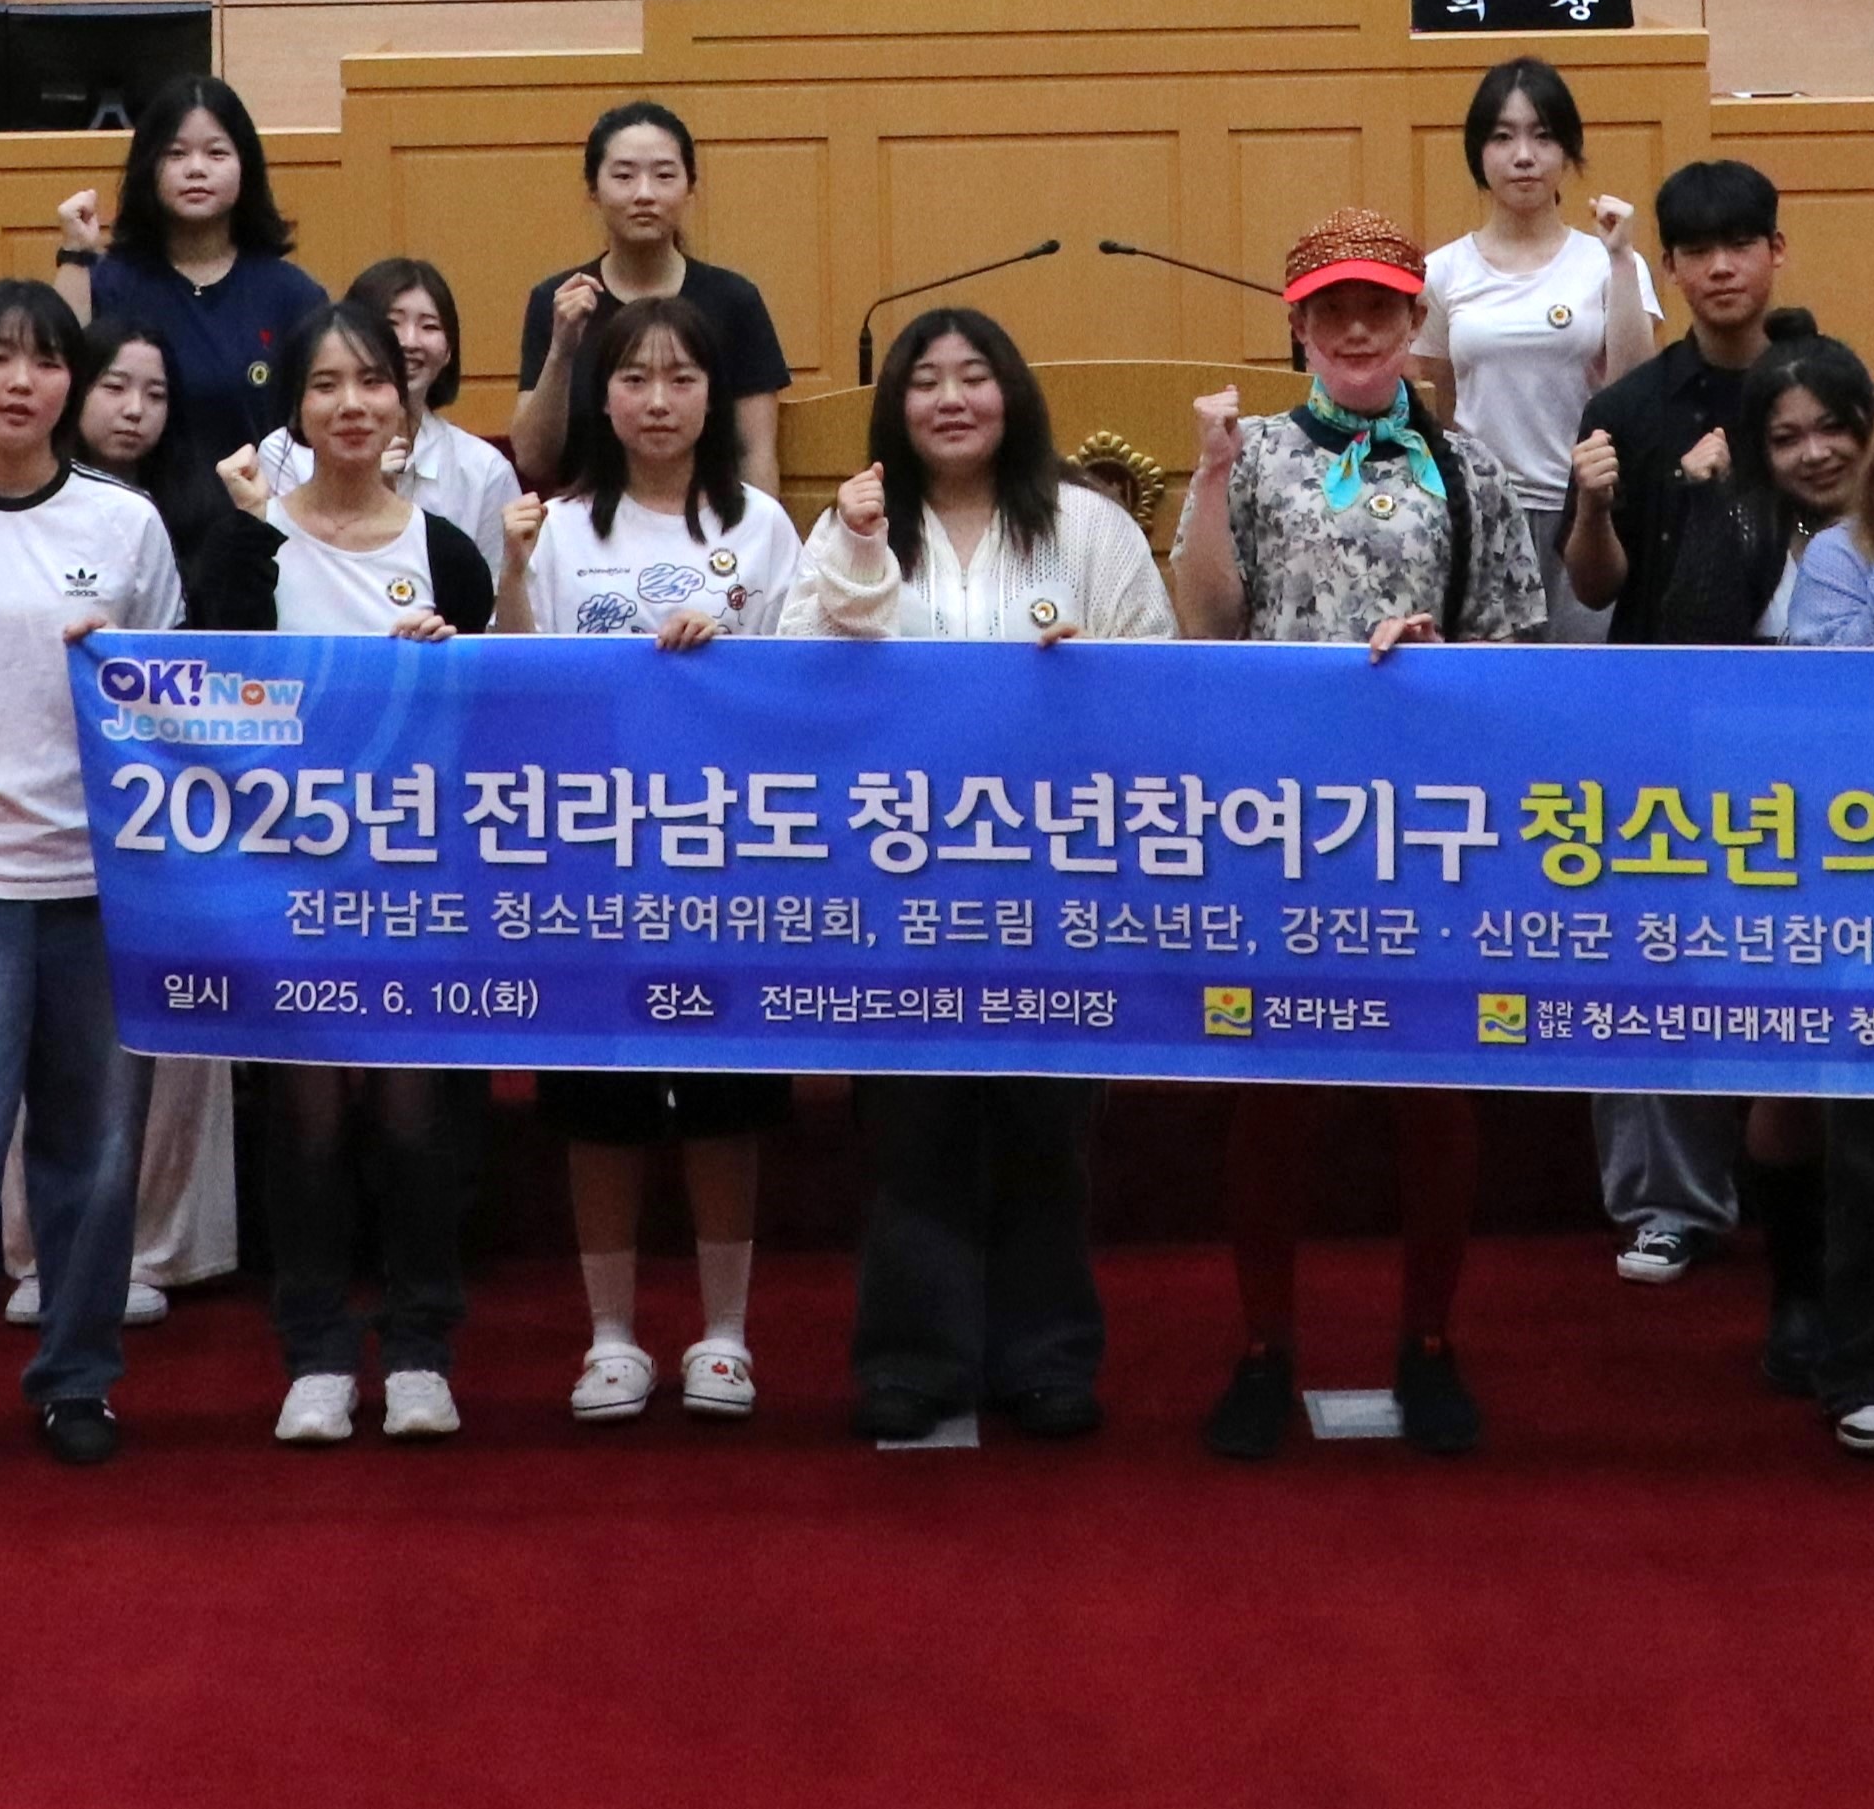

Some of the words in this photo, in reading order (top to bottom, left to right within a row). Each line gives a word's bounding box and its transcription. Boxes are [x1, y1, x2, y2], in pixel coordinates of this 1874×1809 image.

[100, 660, 205, 707] OK!
[102, 706, 302, 743] Jeonnam
[111, 763, 437, 861] 2025년
[463, 765, 828, 866] 전라남도
[848, 771, 1498, 881] 청소년참여기구
[1519, 780, 1796, 886] 청소년
[285, 890, 468, 936] 전라남도
[491, 892, 876, 947] 청소년참여위원회,
[899, 899, 1032, 945] 꿈드림
[1058, 900, 1256, 955] 청소년단,
[1281, 907, 1419, 954] 강진군
[1472, 911, 1612, 958] 신안군
[164, 975, 227, 1010] 일시
[275, 980, 367, 1014] 2025.
[383, 982, 412, 1014] 6.
[432, 979, 538, 1018] 10.(화)
[647, 983, 714, 1019] 장소
[760, 985, 962, 1022] 전라남도의회
[979, 988, 1117, 1026] 본회의장
[1264, 997, 1390, 1030] 전라남도
[1536, 1000, 1574, 1018] 전라
[1537, 1019, 1574, 1039] 남도
[1582, 1002, 1833, 1043] 청소년미래재단
